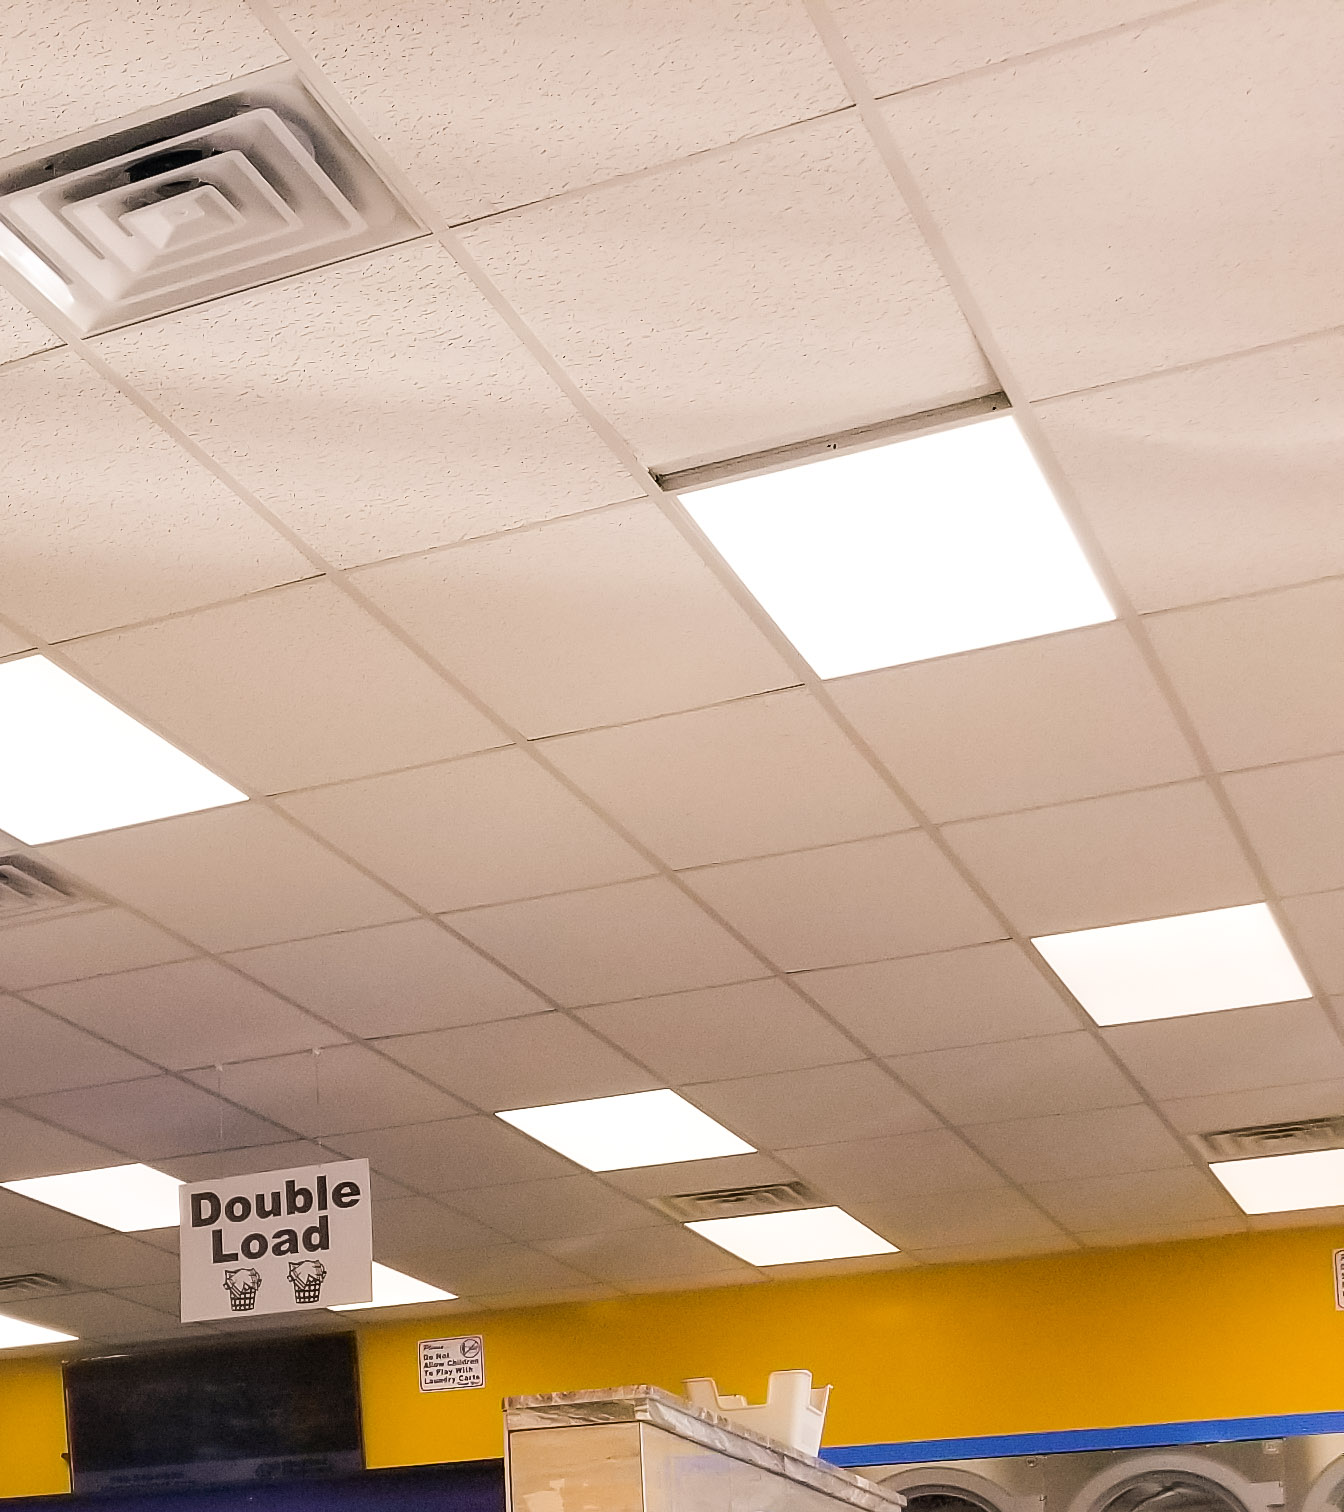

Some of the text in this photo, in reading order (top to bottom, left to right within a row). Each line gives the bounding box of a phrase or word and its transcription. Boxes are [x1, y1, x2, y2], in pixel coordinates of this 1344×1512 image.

[191, 1175, 361, 1228] Double
[212, 1215, 330, 1264] Load
[424, 1376, 455, 1384] Laundry
